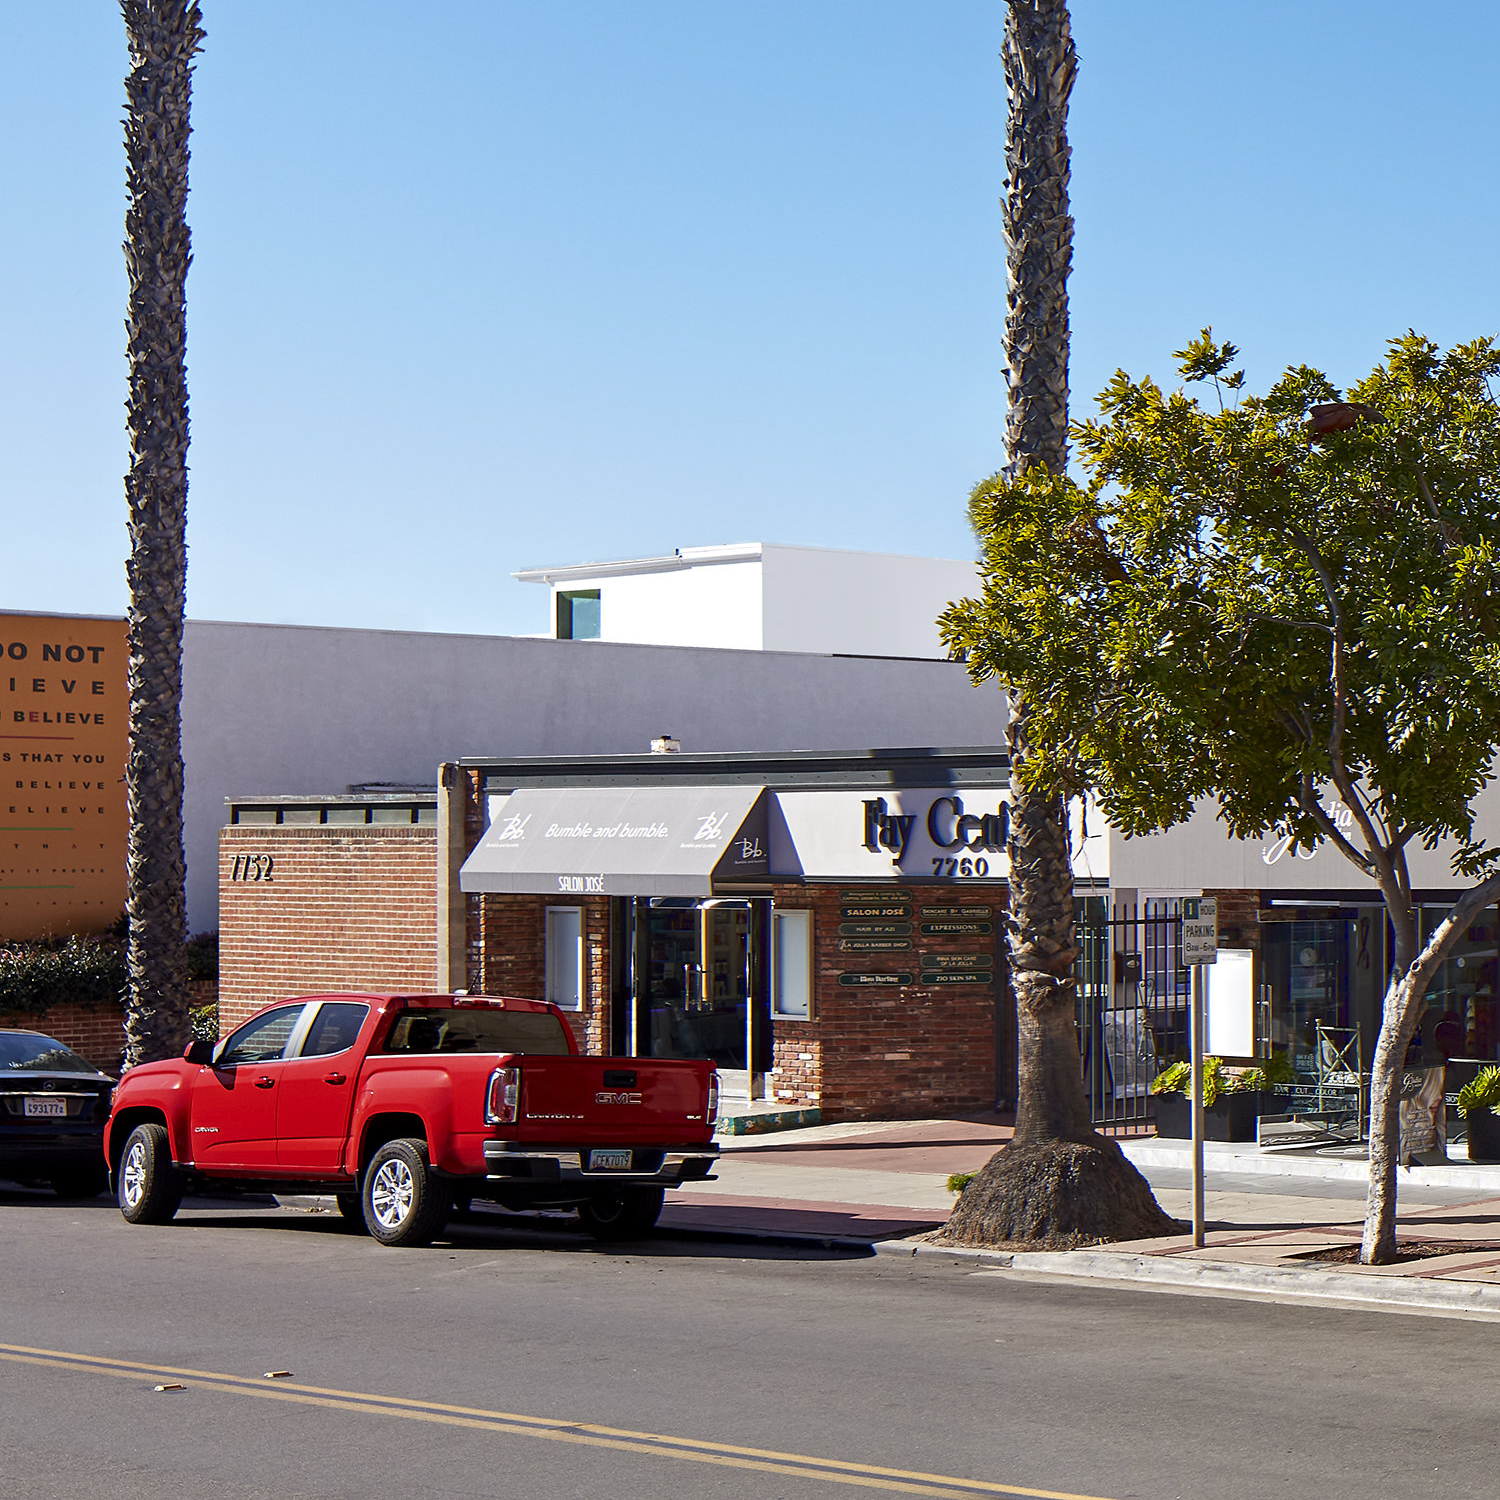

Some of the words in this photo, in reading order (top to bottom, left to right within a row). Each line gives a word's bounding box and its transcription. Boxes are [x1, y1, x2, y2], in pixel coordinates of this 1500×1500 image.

[0, 642, 28, 661] O
[42, 643, 105, 664] NOT
[9, 677, 105, 695] IEVE
[13, 710, 105, 725] BELIEVE
[20, 753, 64, 763] THAT
[73, 754, 105, 764] YOU
[15, 780, 105, 790] BELIEVE
[9, 806, 105, 814] ELIEVE
[544, 823, 593, 838] Bumble
[593, 823, 622, 838] and
[619, 823, 669, 838] bumble.
[861, 797, 917, 868] Fay
[228, 854, 273, 881] 7752
[932, 856, 989, 877] 7760
[558, 876, 584, 892] SALON
[584, 873, 605, 892] JOSÉ
[881, 906, 904, 916] JOSÉ
[1186, 924, 1215, 937] PARKING
[595, 1092, 643, 1105] GMC
[1296, 1087, 1309, 1095] CUT
